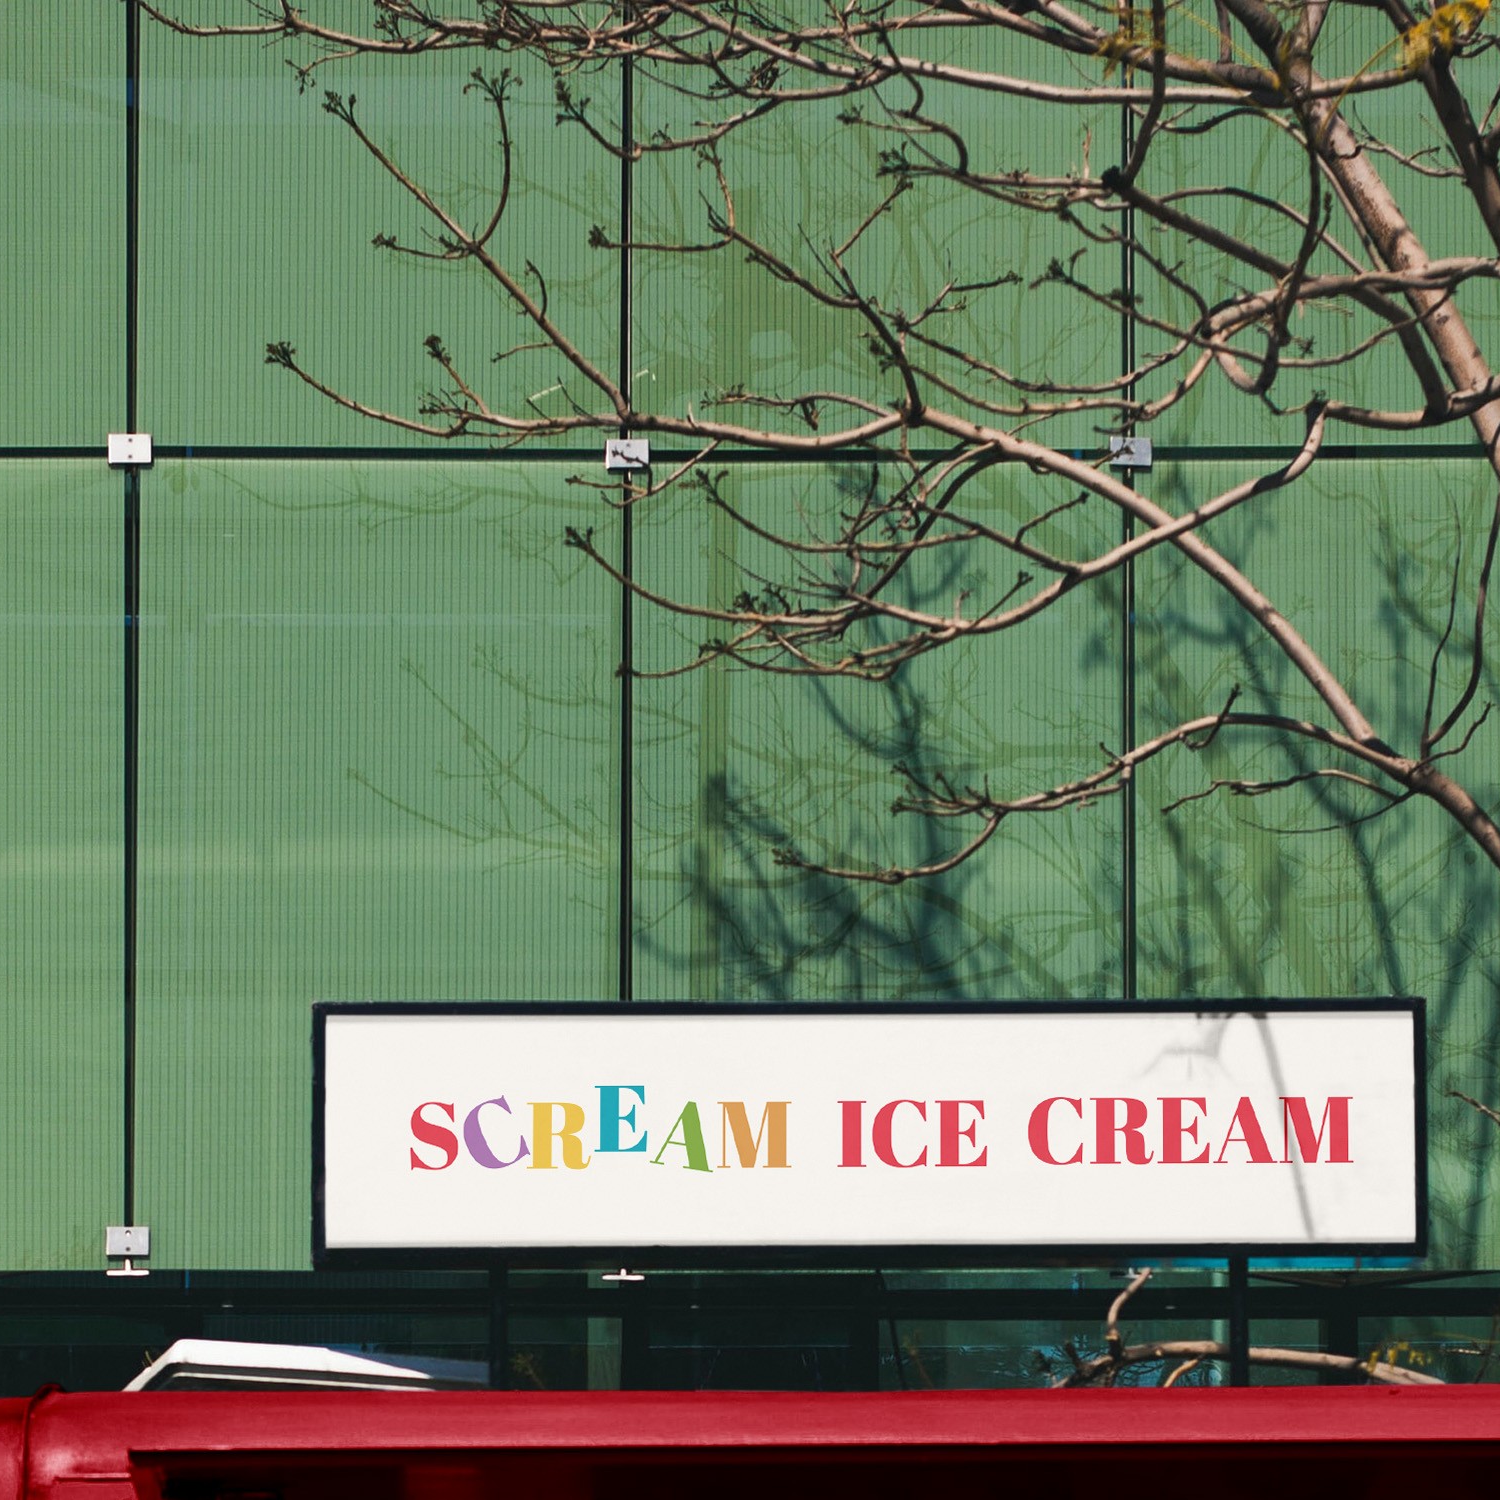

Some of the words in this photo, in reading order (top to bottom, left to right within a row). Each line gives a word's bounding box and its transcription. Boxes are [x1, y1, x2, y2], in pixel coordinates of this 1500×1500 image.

[409, 1085, 792, 1173] SCREAM
[837, 1099, 988, 1169] ICE
[1027, 1096, 1354, 1166] CREAM
